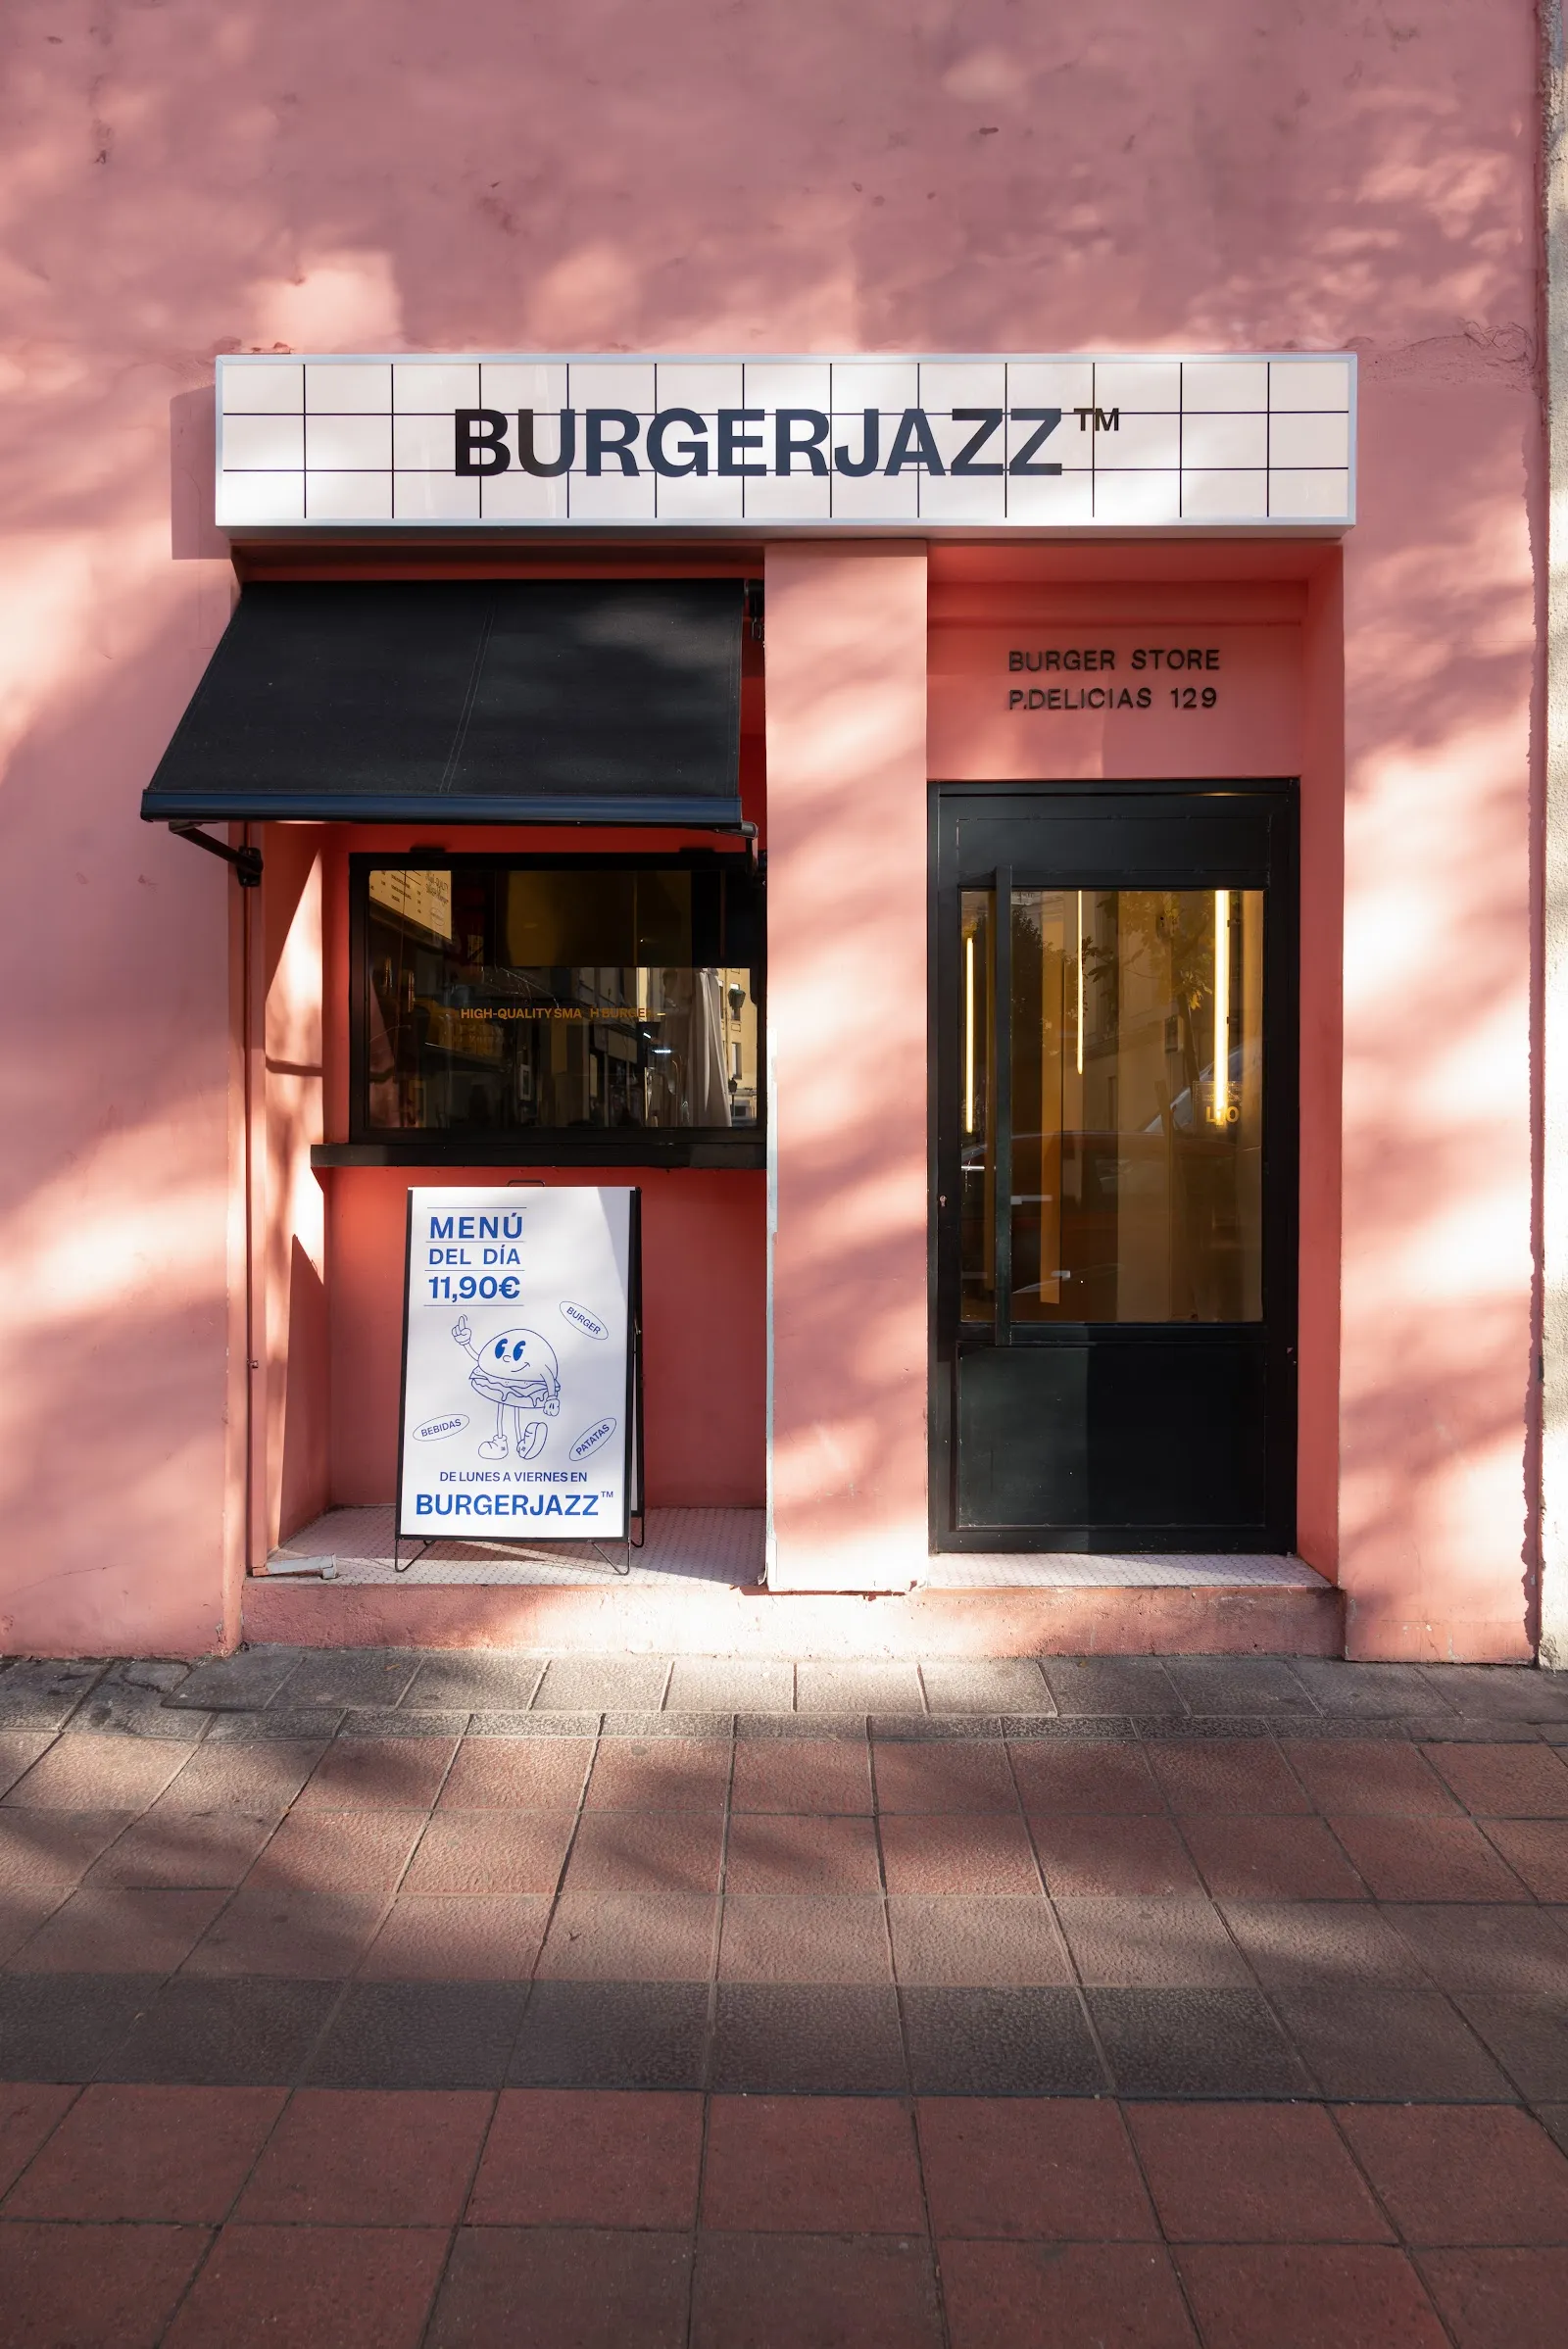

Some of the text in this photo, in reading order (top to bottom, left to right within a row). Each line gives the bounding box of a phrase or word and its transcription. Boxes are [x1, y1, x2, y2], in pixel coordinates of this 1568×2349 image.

[1008, 649, 1220, 671] BURGER STORE
[1008, 687, 1217, 710] P.DELICIAS 129
[461, 1007, 552, 1020] HIGH-QUALITY
[554, 1007, 599, 1020] SMAH
[429, 1212, 522, 1240] MENÚ
[428, 1244, 521, 1265] DEL DÍA
[428, 1275, 520, 1303] 11,90€
[566, 1306, 601, 1335] BURGER
[420, 1418, 462, 1438] BEBIDAS
[575, 1424, 610, 1455] PATATAS
[440, 1471, 588, 1482] DE LUNES A VIERNES EN
